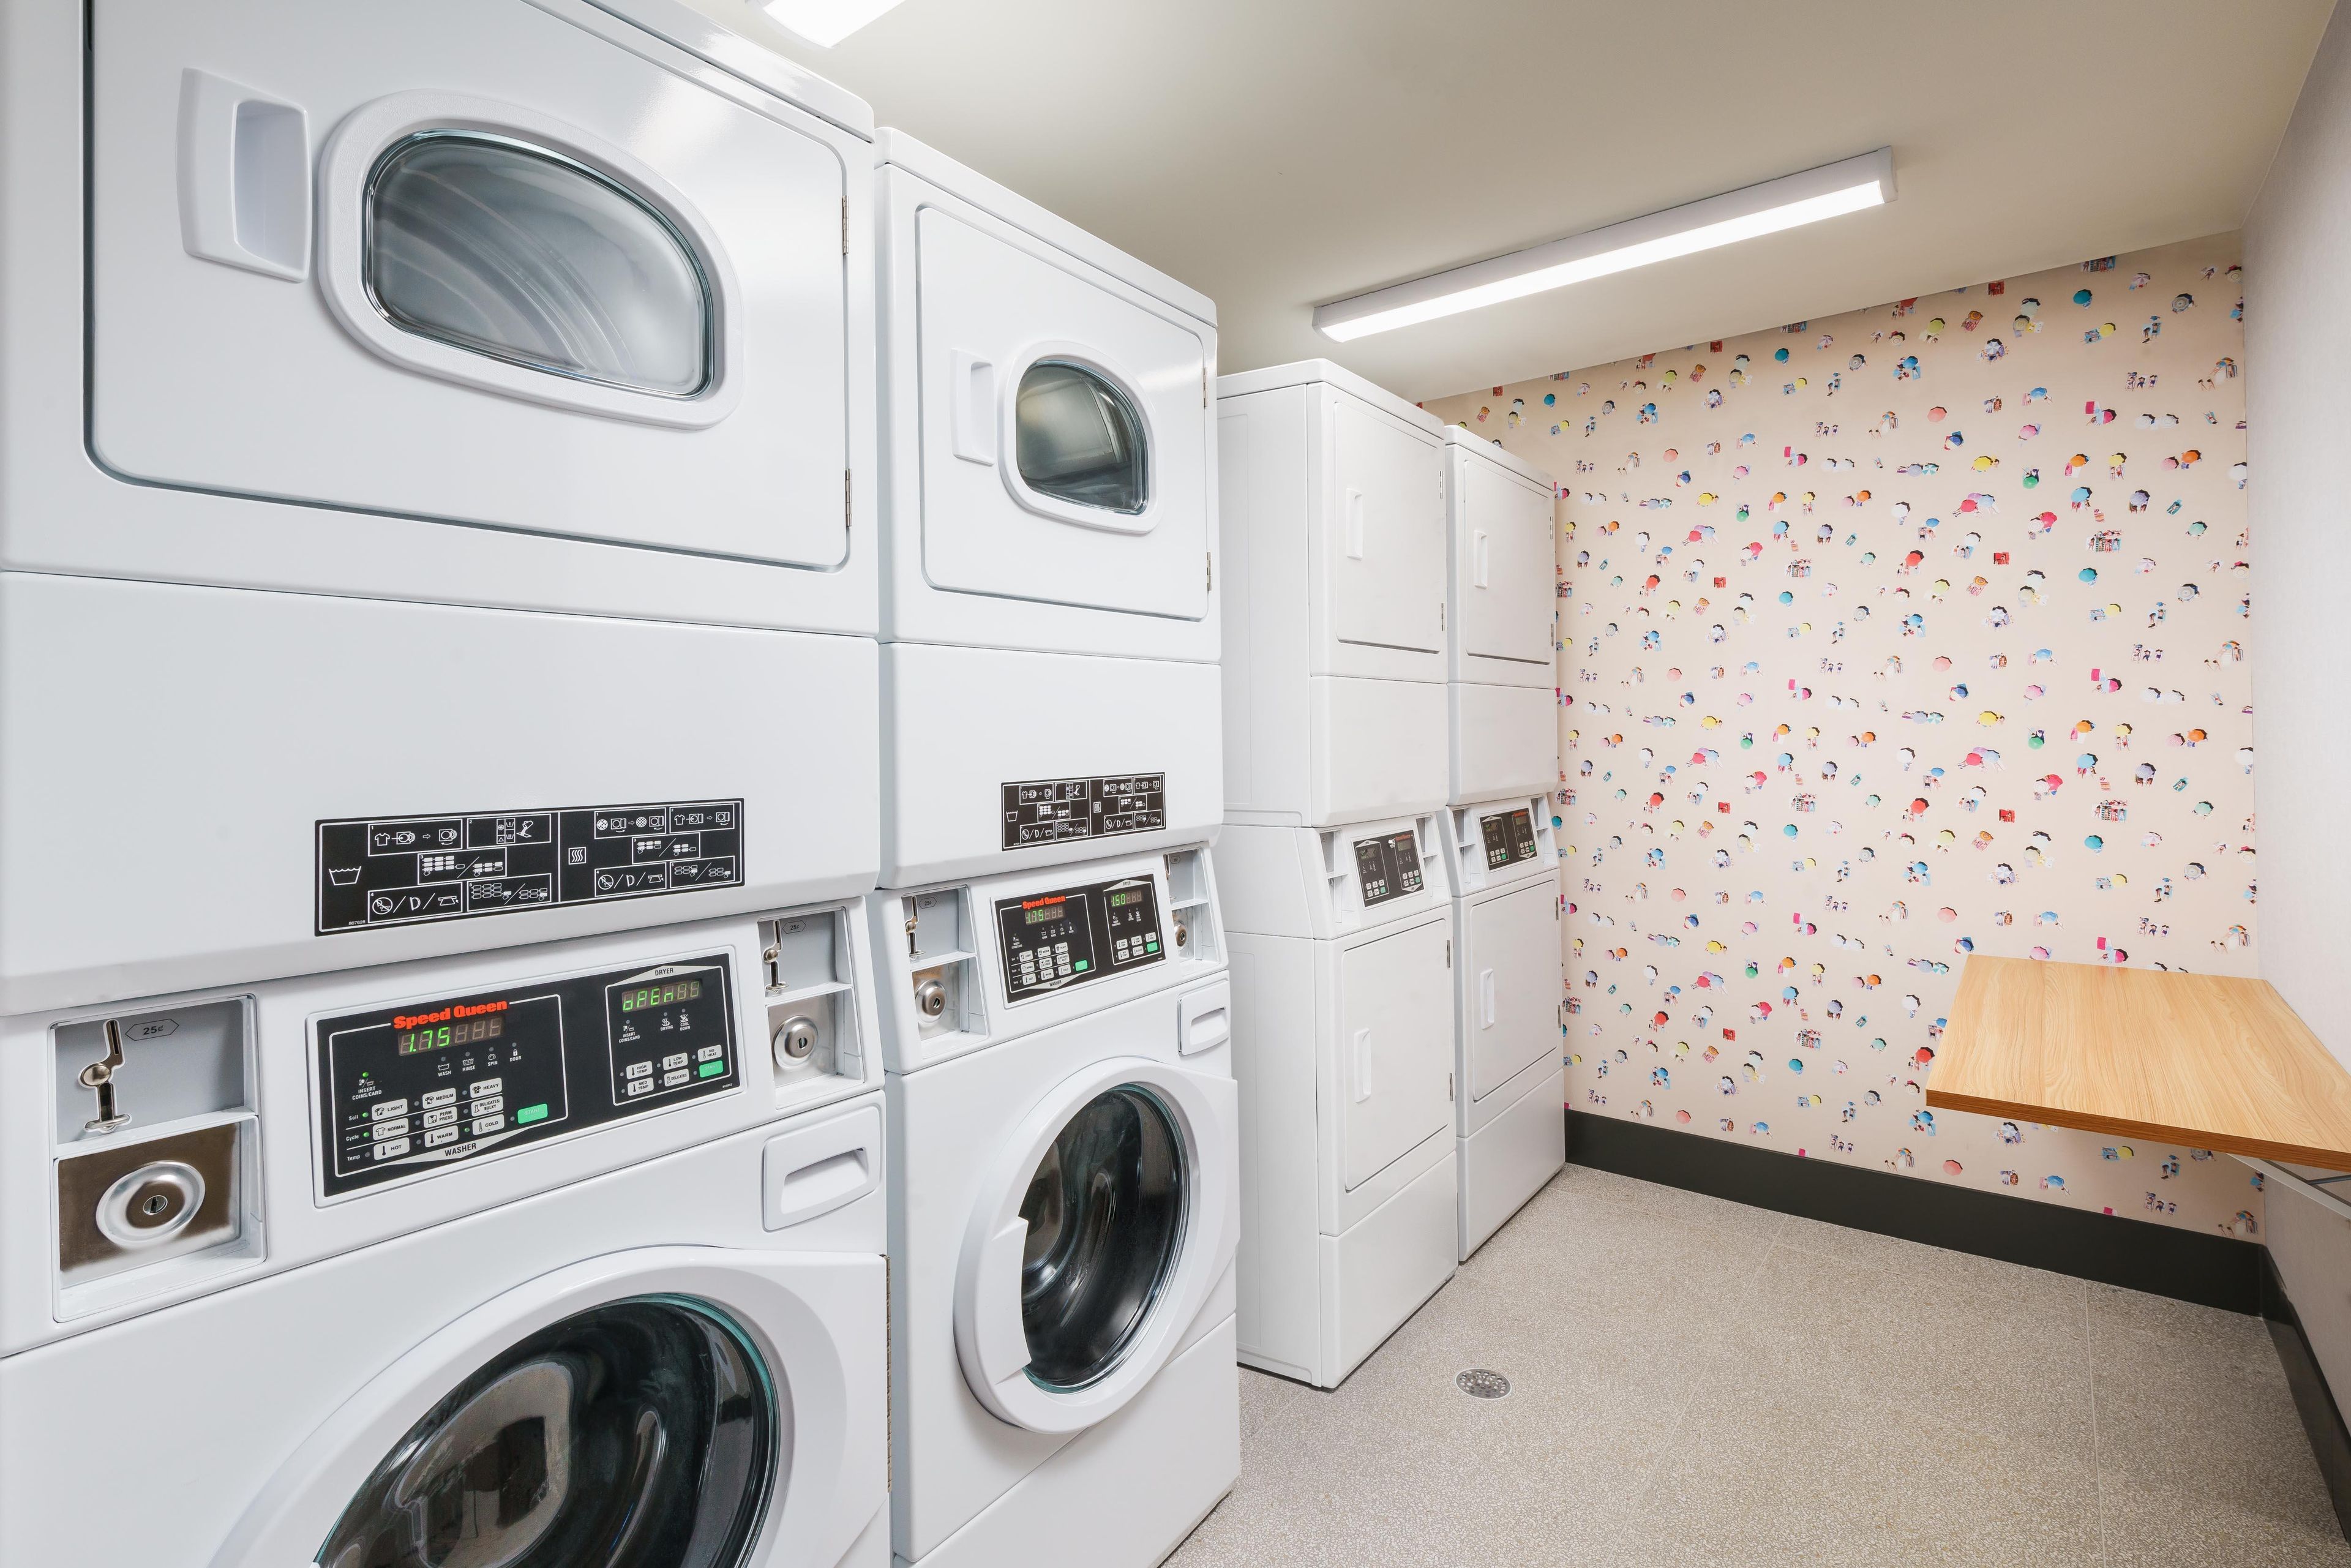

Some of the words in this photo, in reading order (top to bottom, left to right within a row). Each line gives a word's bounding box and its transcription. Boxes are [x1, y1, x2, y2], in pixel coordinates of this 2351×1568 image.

[1022, 900, 1044, 910] Speed
[655, 967, 673, 976] DRYER
[394, 1008, 451, 1029] Speed
[454, 1000, 508, 1018] Queen
[143, 1025, 163, 1035] 25¢
[409, 1027, 449, 1052] 1.75
[352, 1090, 382, 1100] COINS/CARD
[479, 1098, 500, 1107] DELICATES/
[444, 1142, 477, 1157] WASHER
